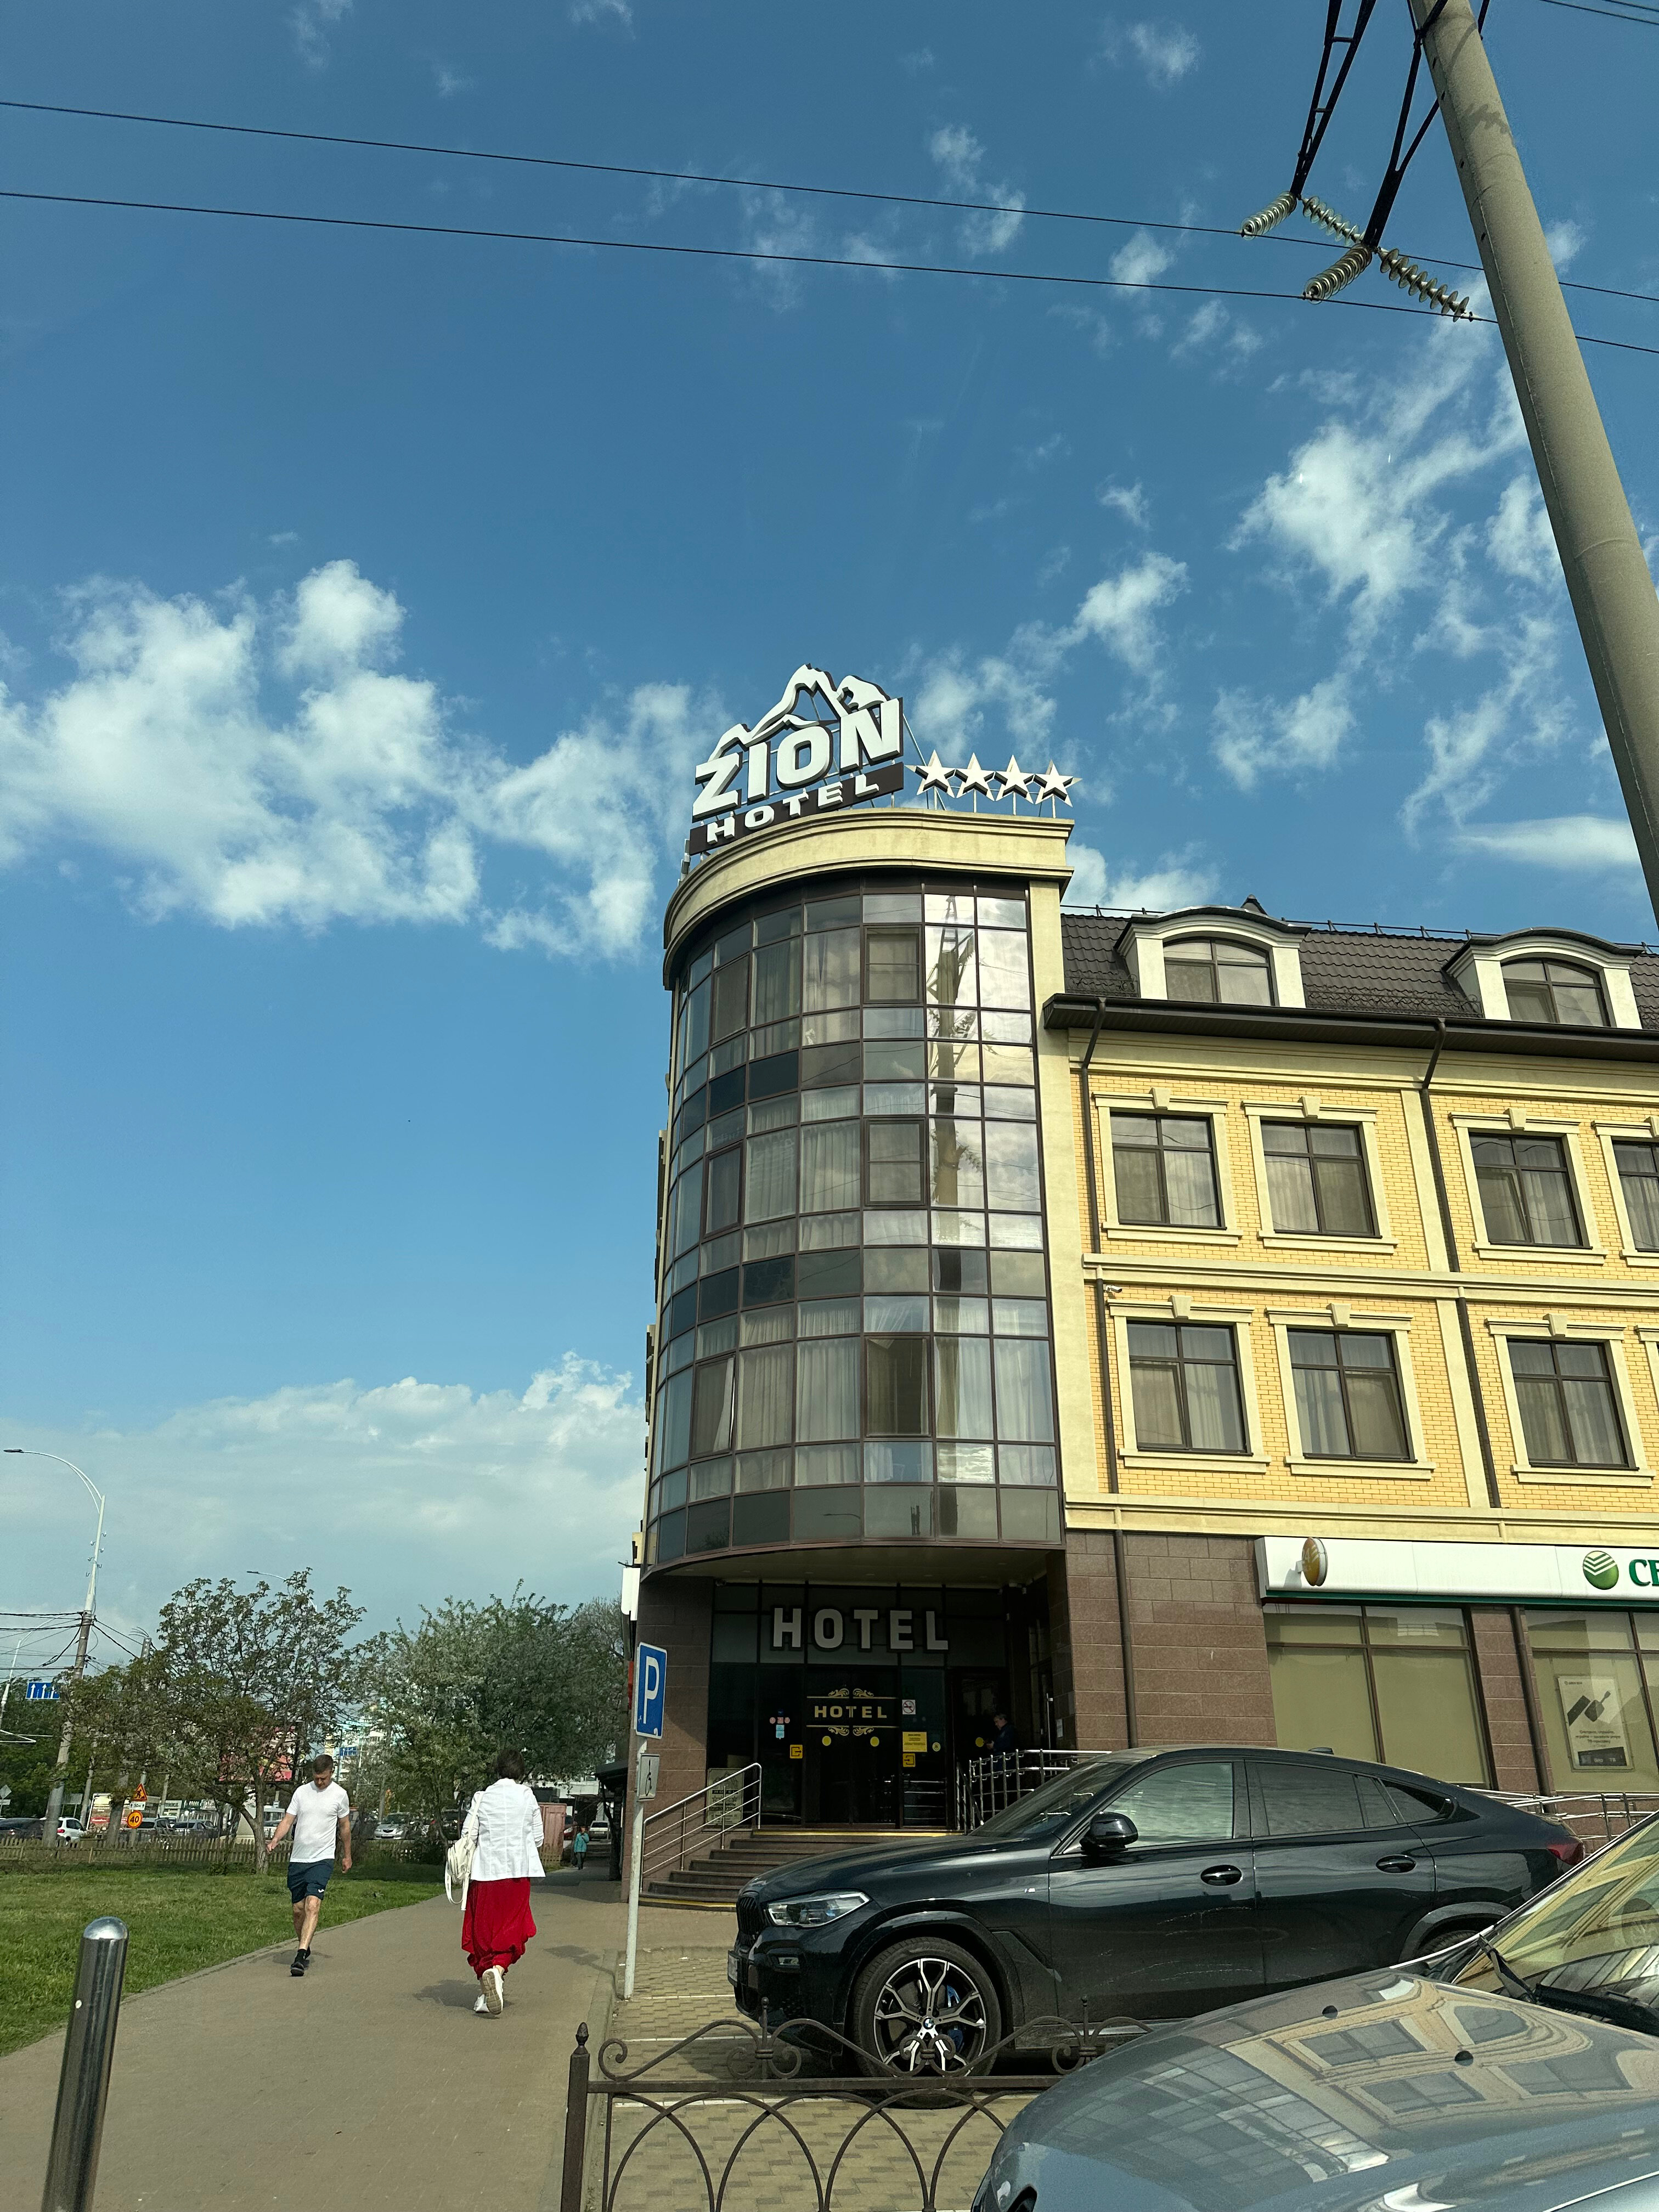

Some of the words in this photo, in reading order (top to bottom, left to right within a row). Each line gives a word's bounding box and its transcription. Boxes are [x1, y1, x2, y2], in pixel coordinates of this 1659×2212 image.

[692, 698, 902, 821] ZION
[707, 773, 879, 844] HOTEL
[773, 1607, 949, 1650] HOTEL
[643, 1655, 659, 1724] P
[814, 1706, 887, 1718] HOTEL
